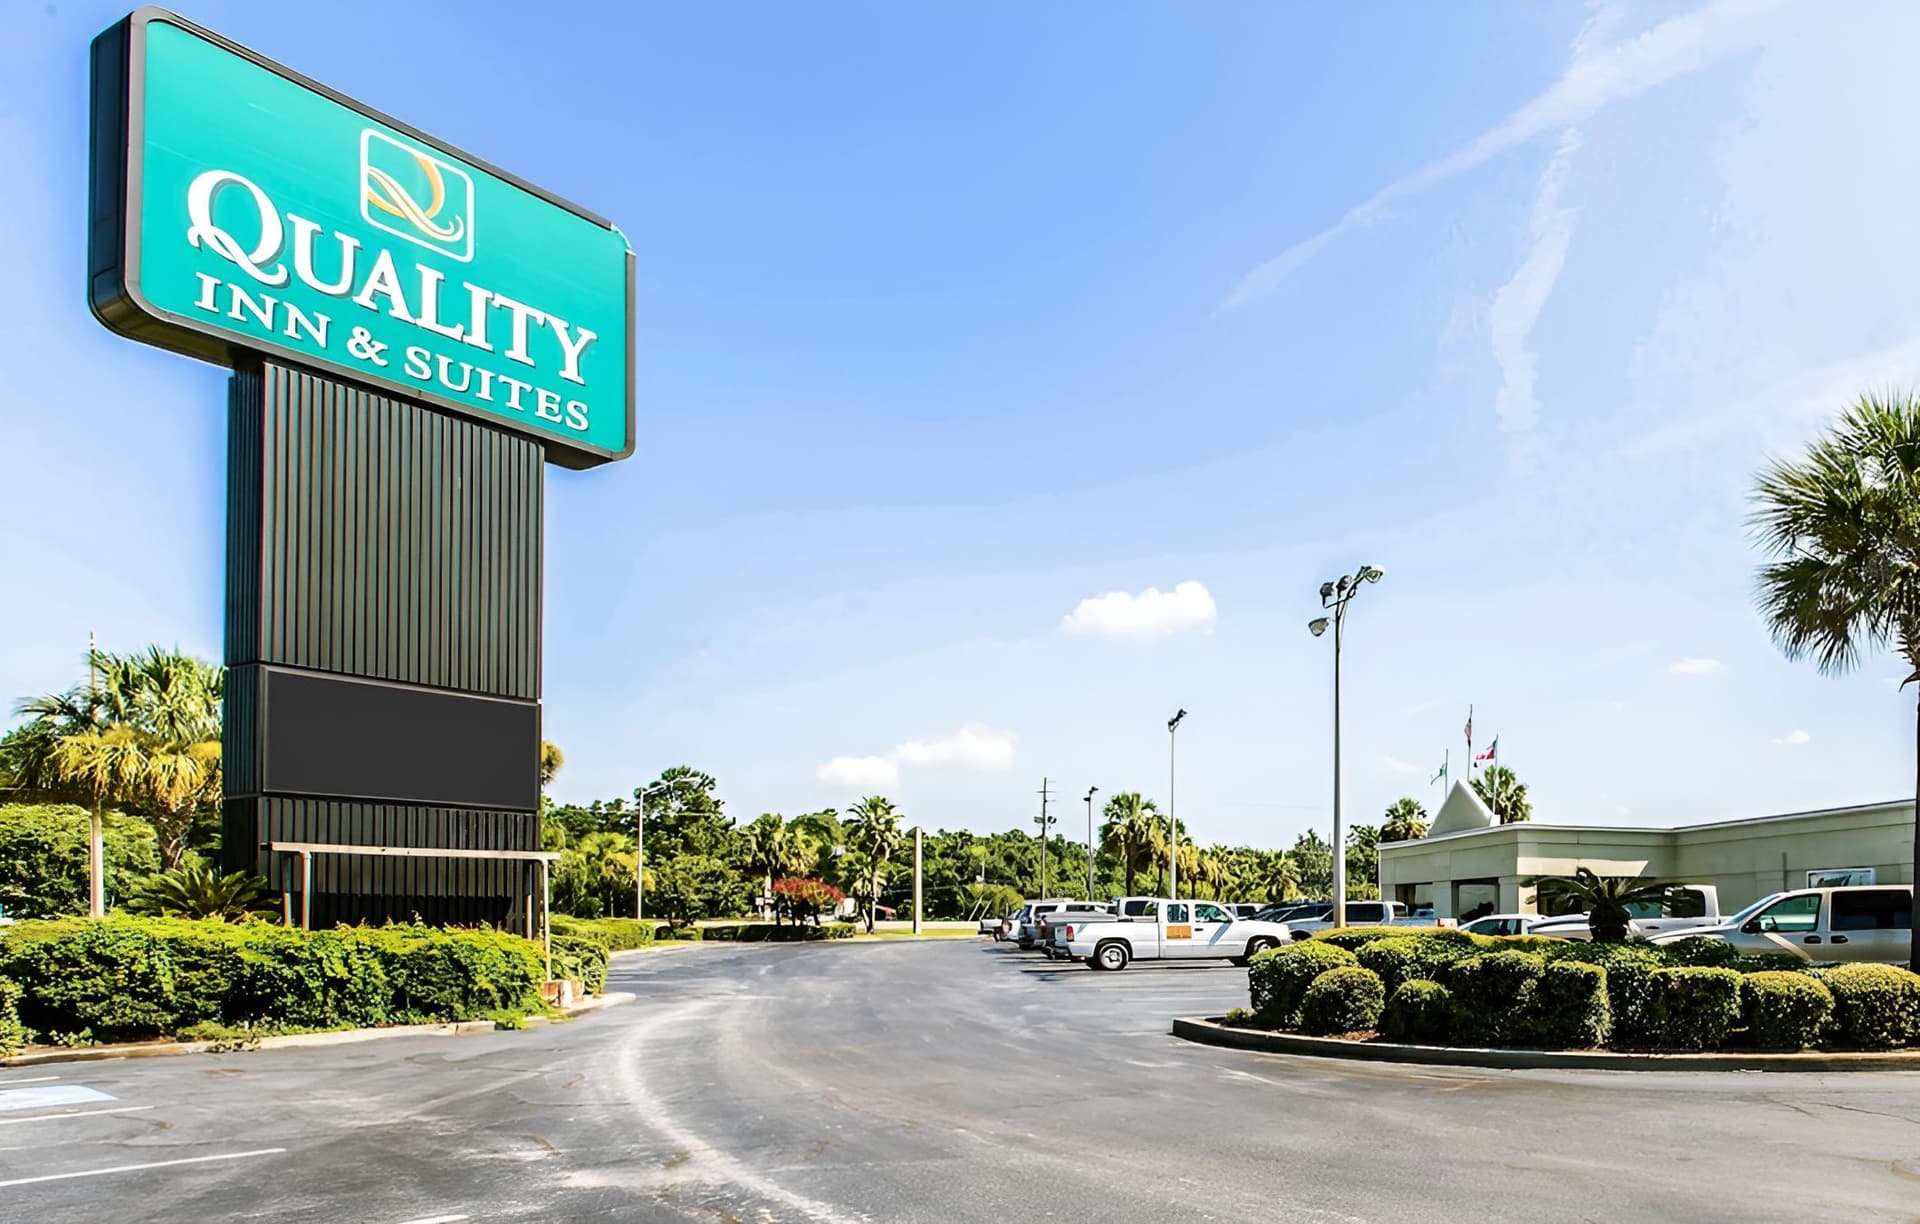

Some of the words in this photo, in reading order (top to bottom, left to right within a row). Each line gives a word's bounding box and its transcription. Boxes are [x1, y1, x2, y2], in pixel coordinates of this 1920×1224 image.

[187, 170, 597, 385] QUALITY
[195, 272, 331, 347] INN
[346, 327, 388, 367] &
[404, 346, 589, 431] SUITES
